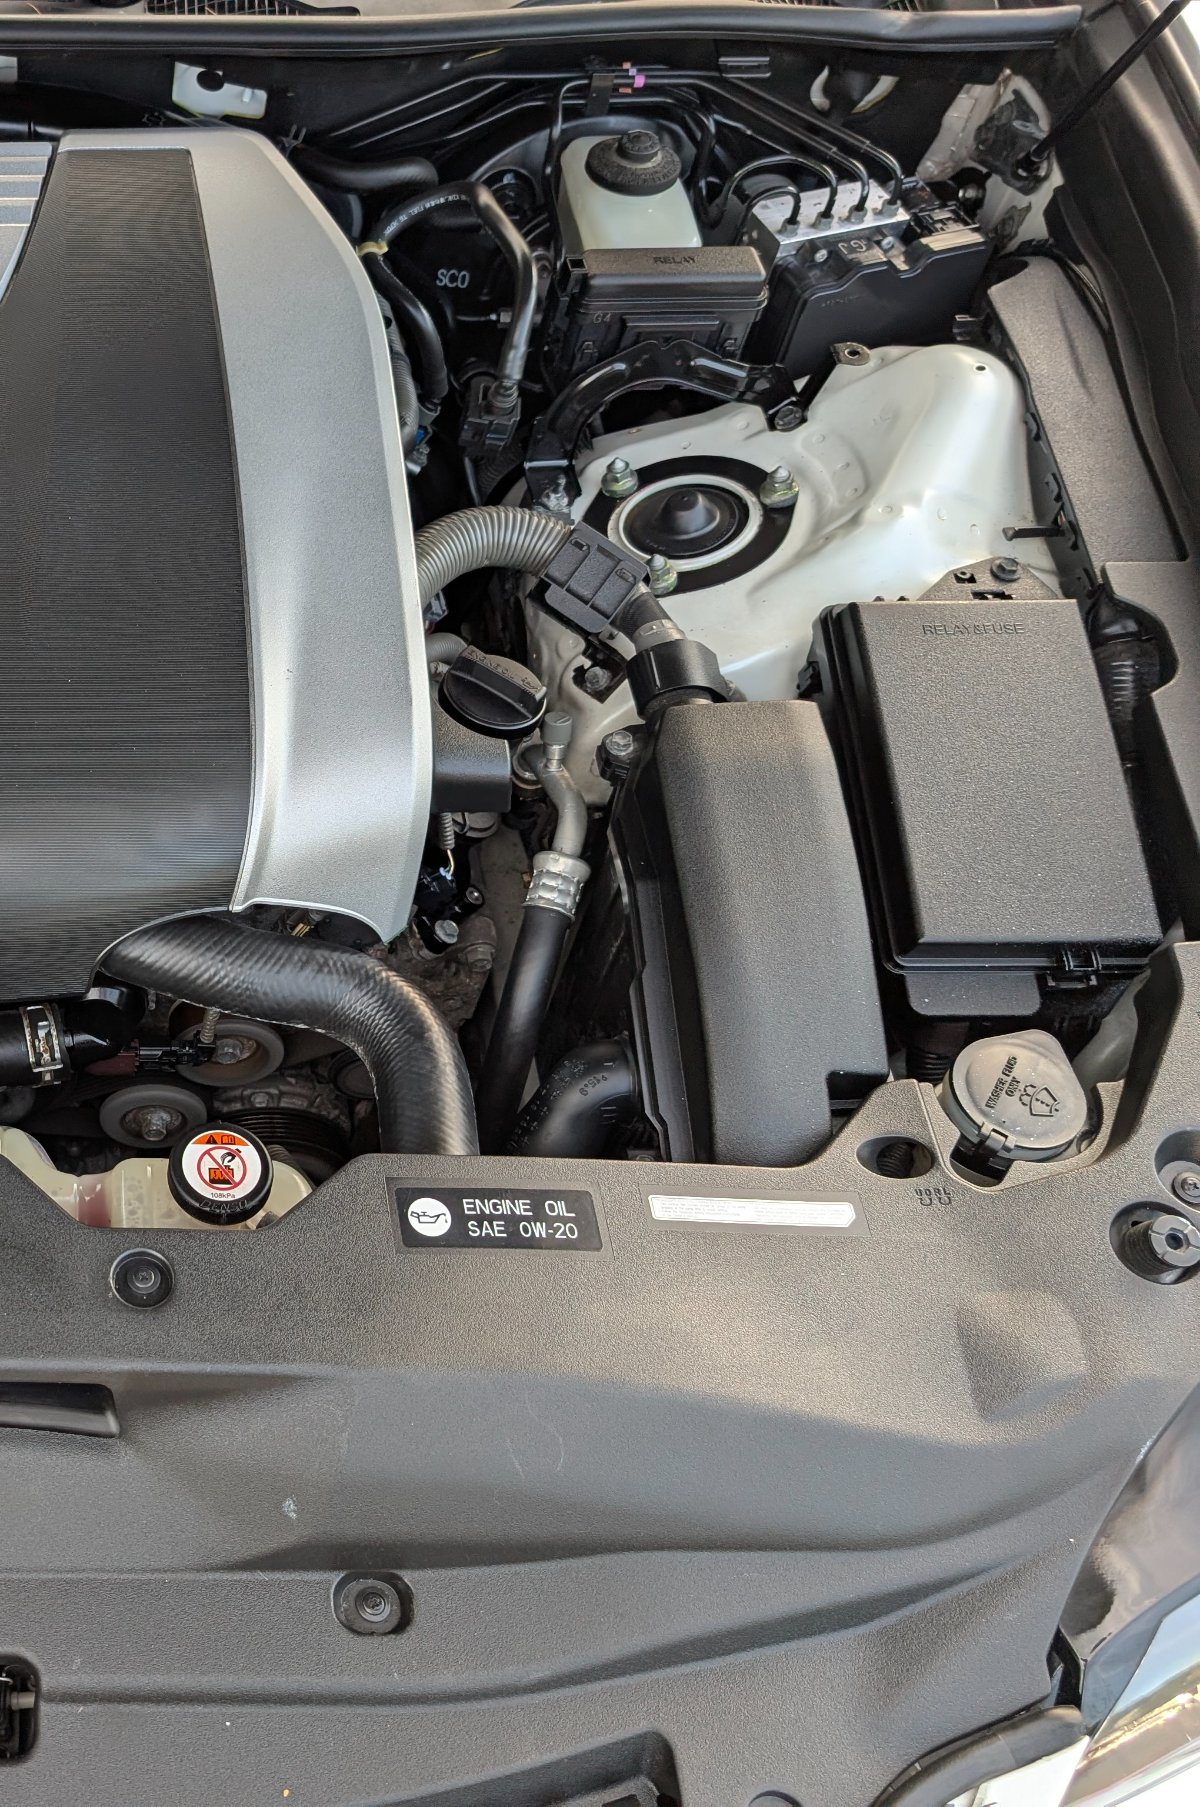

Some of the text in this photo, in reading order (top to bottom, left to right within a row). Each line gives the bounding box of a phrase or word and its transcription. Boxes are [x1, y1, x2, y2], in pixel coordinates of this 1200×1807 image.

[653, 256, 696, 265] RELAY
[462, 1198, 577, 1217] ENGINE OIL
[467, 1220, 579, 1239] SAE 0W-20
